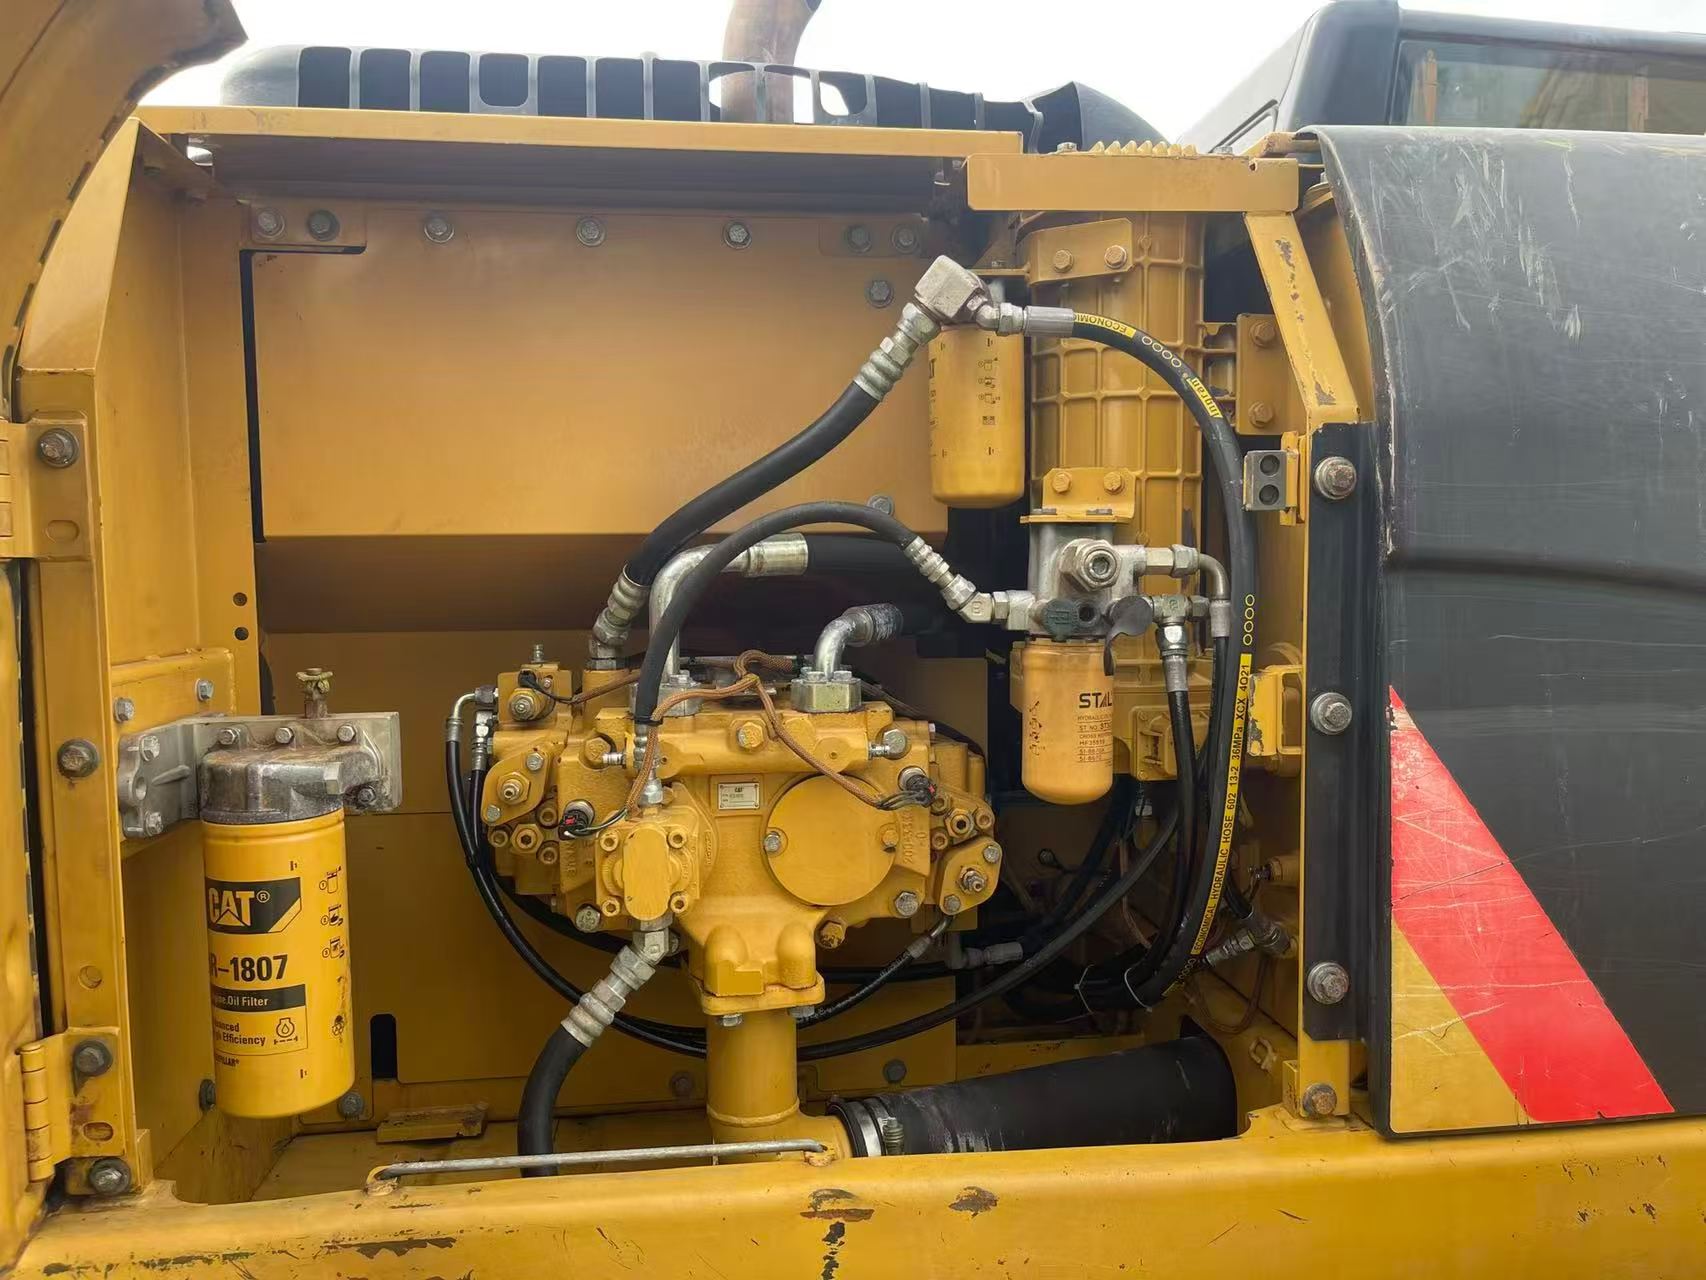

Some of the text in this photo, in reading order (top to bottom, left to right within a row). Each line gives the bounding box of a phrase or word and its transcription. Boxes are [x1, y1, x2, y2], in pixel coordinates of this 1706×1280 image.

[1194, 664, 1250, 950] ECONOMICAL HYDRAULIC HOSE 602 13-2 36MPa XCX 4Q21
[228, 996, 240, 1006] Oil
[242, 996, 268, 1006] Filter
[222, 1031, 266, 1046] Efficiency
